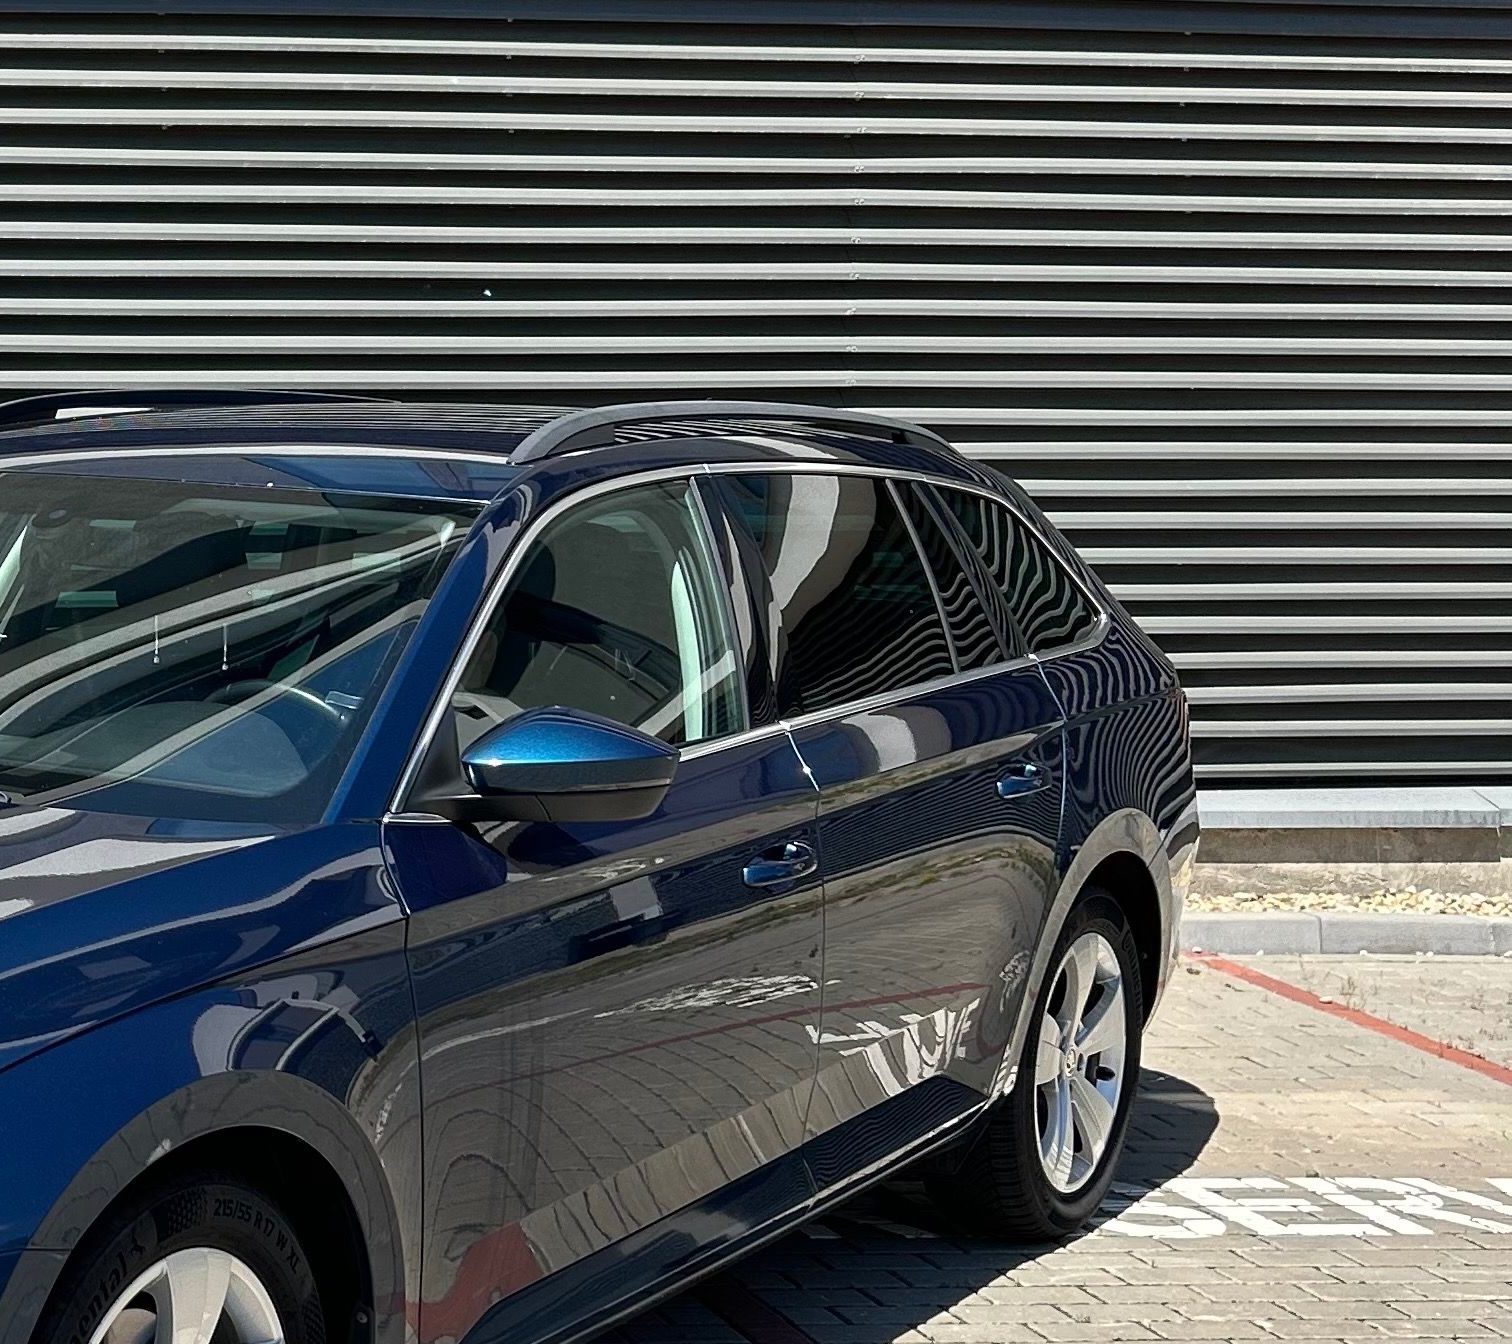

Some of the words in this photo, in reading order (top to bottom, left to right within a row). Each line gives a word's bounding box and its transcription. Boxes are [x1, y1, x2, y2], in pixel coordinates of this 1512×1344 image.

[214, 1198, 252, 1223] 215/55
[254, 1210, 264, 1229] R
[264, 1218, 276, 1237] 17
[288, 1246, 301, 1274] XL
